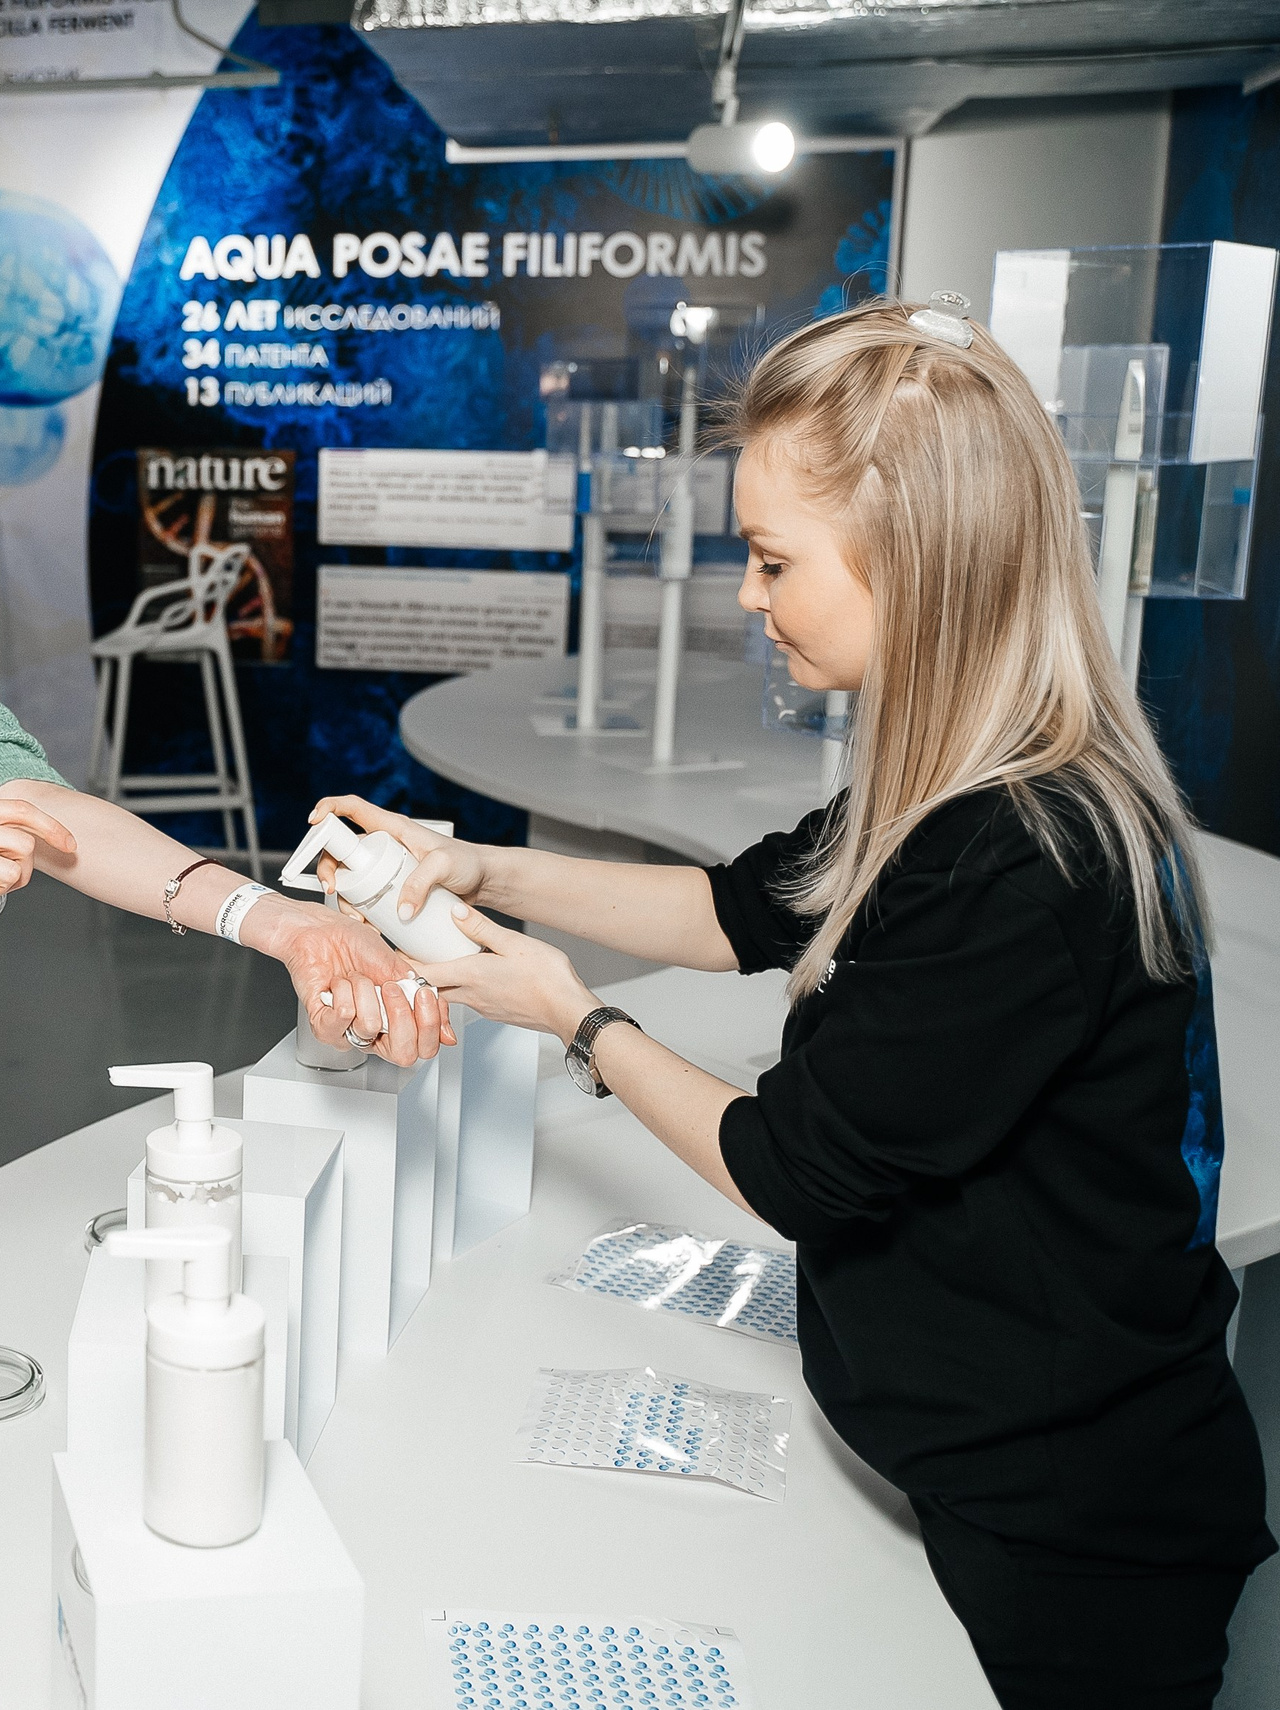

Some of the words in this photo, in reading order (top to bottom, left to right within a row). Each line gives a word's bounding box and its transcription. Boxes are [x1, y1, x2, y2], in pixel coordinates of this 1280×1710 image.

[179, 234, 321, 282] AQUA
[333, 231, 491, 279] POSAE
[502, 231, 768, 278] FILIFORMIS
[181, 300, 221, 332] 26
[223, 299, 281, 332] ЛЕТ
[284, 300, 501, 332] ИССЛЕДОВАНИЙ
[181, 338, 221, 370] 34
[225, 343, 330, 369] ПАТЕНТА
[184, 376, 221, 407] 13
[225, 377, 392, 408] ПУБЛИКАЦИЙ
[147, 455, 287, 491] nature
